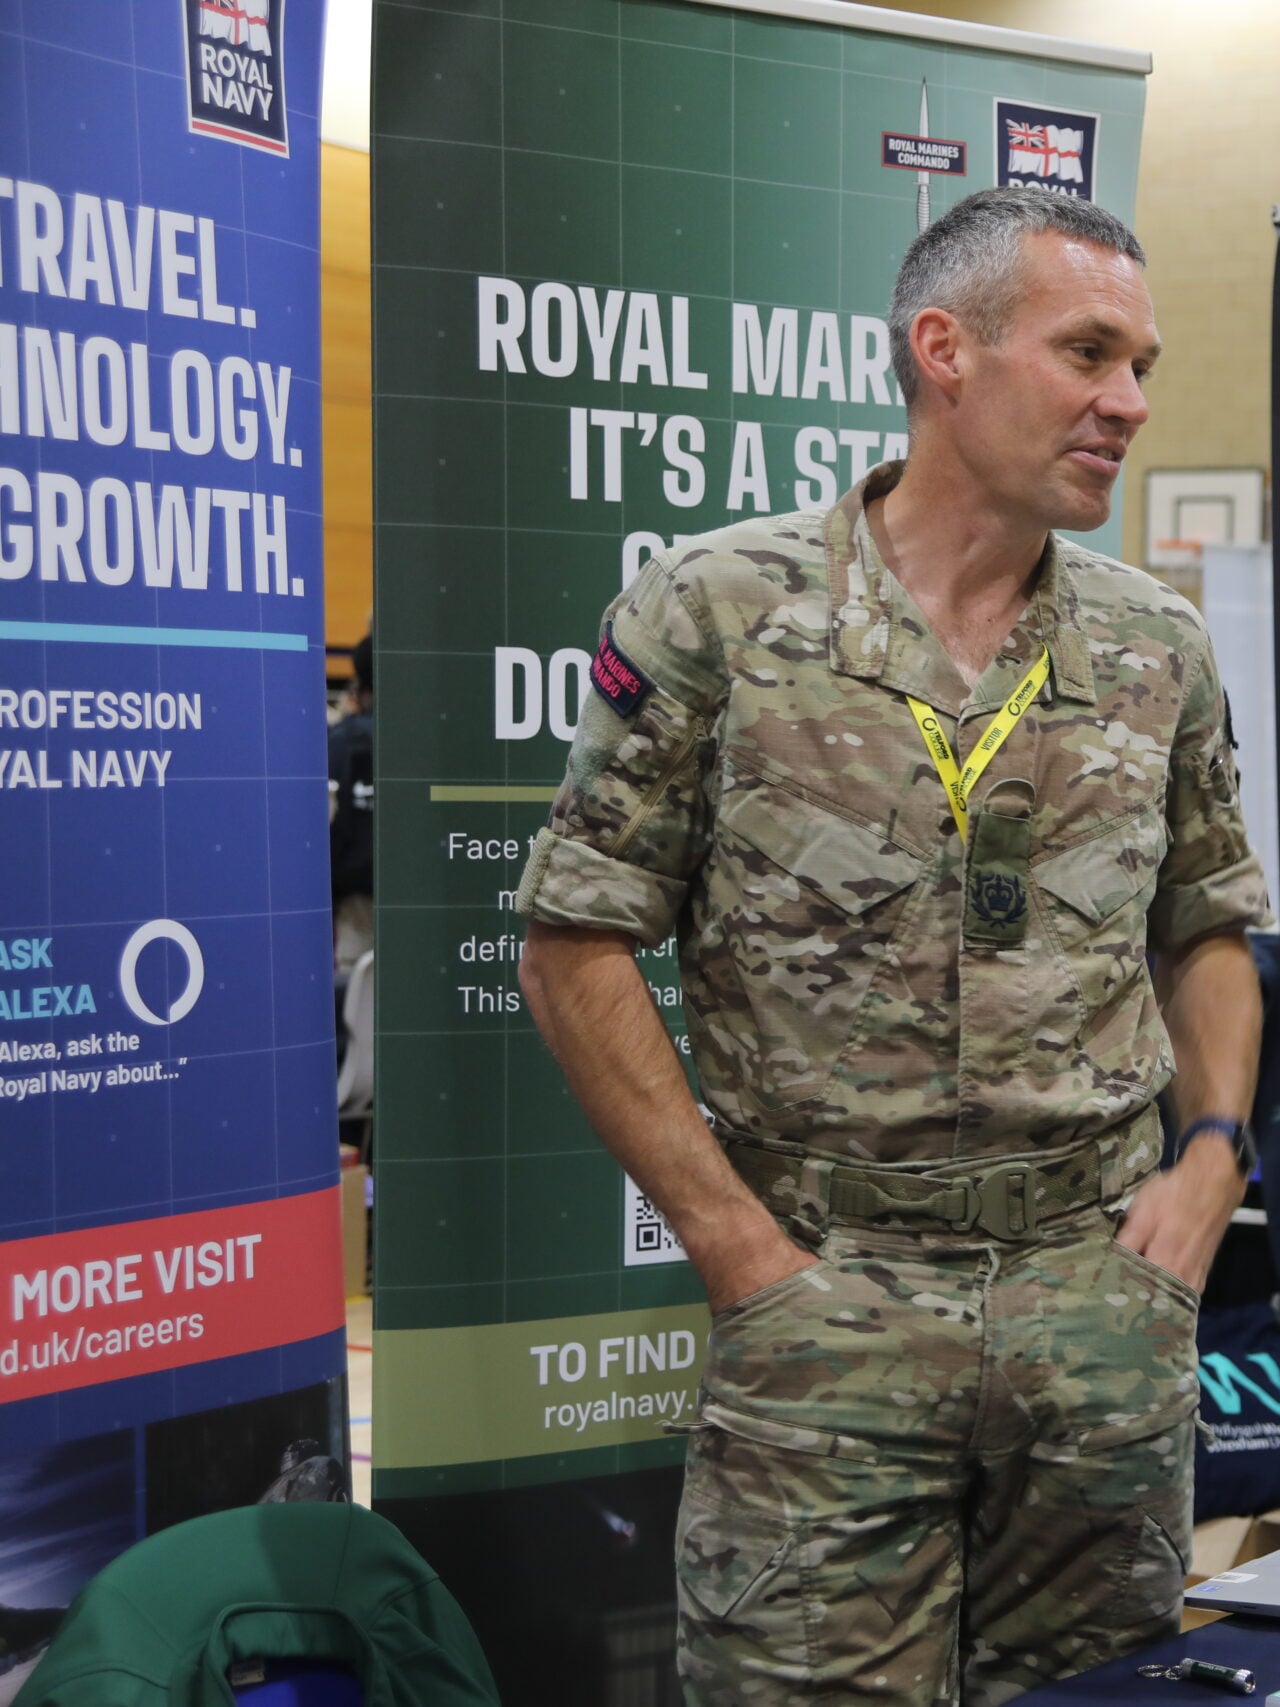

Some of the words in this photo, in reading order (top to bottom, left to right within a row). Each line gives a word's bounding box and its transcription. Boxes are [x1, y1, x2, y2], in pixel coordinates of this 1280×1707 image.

[201, 43, 272, 91] ROYAL
[203, 72, 272, 121] NAVY
[888, 138, 917, 153] ROYAL
[918, 141, 959, 159] MARINES
[897, 152, 950, 171] COMMANDO
[477, 276, 708, 390] ROYAL
[732, 302, 909, 407] MAR
[726, 421, 771, 512] A
[0, 468, 304, 596] GROWTH.
[602, 649, 640, 694] MARINES
[0, 690, 201, 729] ROFESSION
[933, 729, 949, 760] TELFORD
[981, 727, 1003, 751] VISITOR
[72, 750, 172, 787] NAVY
[449, 832, 519, 860] Face
[0, 984, 97, 1020] ALEXA
[457, 985, 520, 1013] This
[0, 1040, 62, 1064] Alexa,
[67, 1034, 103, 1057] ask
[107, 1031, 140, 1052] the
[51, 1069, 101, 1094] Navy
[13, 1253, 143, 1321] MORE
[154, 1233, 262, 1294] VISIT
[0, 1312, 204, 1375] d.uk/careers
[530, 1342, 587, 1385] TO
[599, 1329, 696, 1379] FIND
[544, 1388, 700, 1433] royalnavy.
